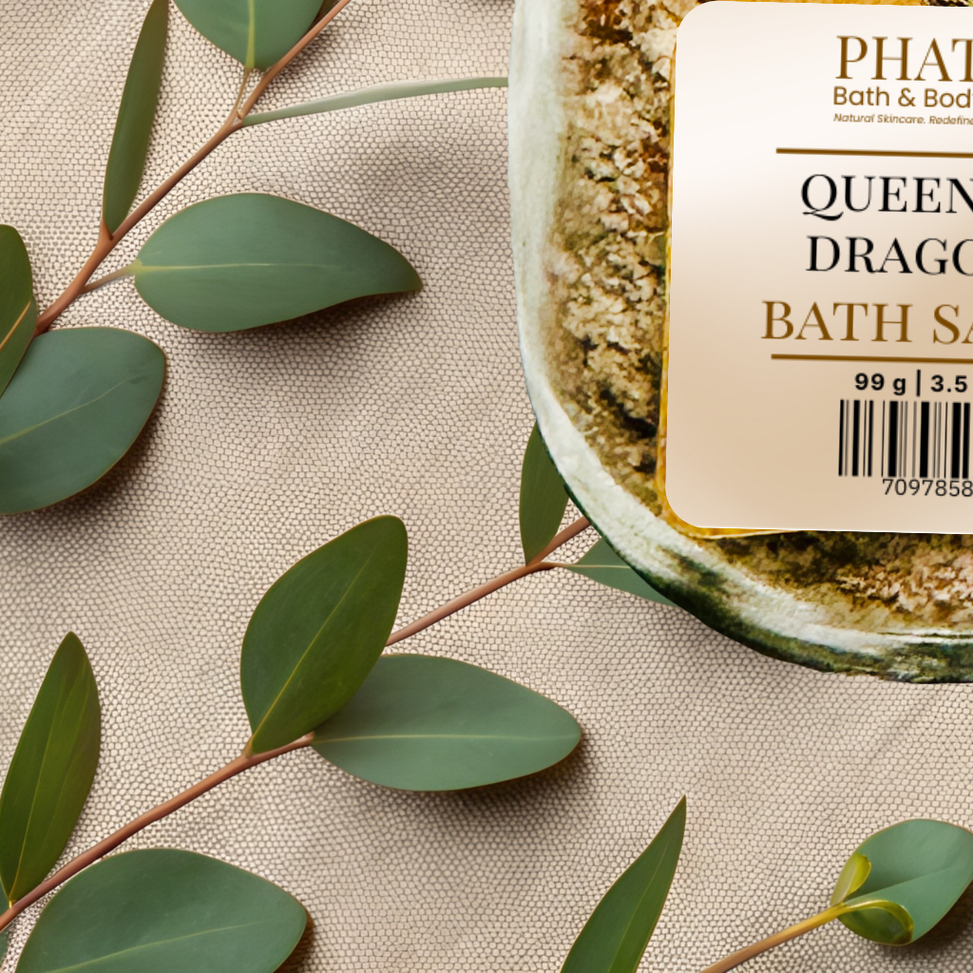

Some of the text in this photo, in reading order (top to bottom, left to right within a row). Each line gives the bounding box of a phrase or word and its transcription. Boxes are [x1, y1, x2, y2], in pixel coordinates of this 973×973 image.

[833, 86, 890, 107] Bath
[897, 87, 916, 108] &
[833, 113, 876, 124] Natural
[877, 114, 927, 125] Skincare.
[761, 300, 913, 343] BATH
[854, 372, 886, 392] 99
[892, 377, 907, 396] g
[930, 374, 969, 394] 3.5
